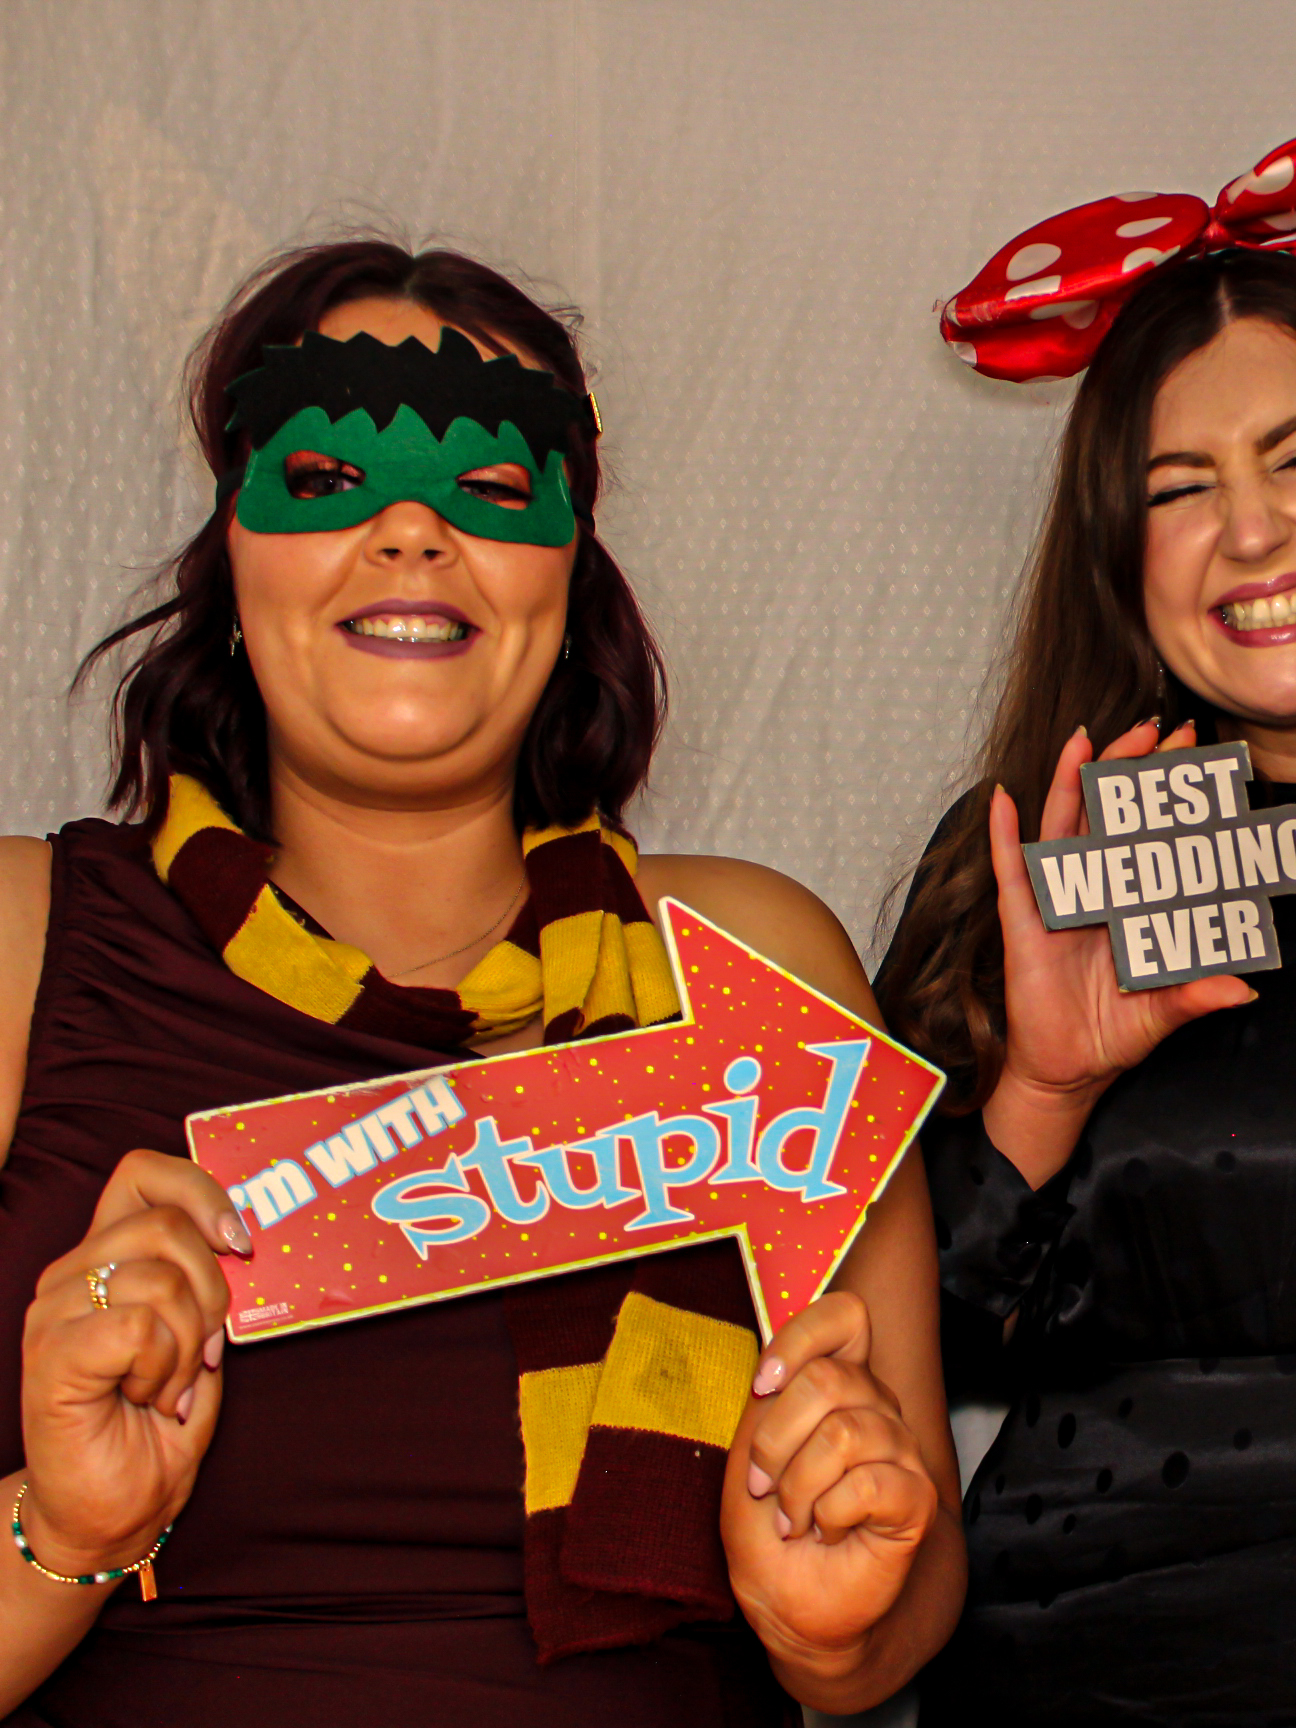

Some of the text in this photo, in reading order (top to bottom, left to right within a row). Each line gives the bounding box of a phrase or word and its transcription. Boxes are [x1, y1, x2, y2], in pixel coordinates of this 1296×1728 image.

[1097, 758, 1239, 836] BEST
[1122, 899, 1266, 978] EVER
[227, 1074, 467, 1236] 'm WITH
[371, 1038, 872, 1261] stupid
